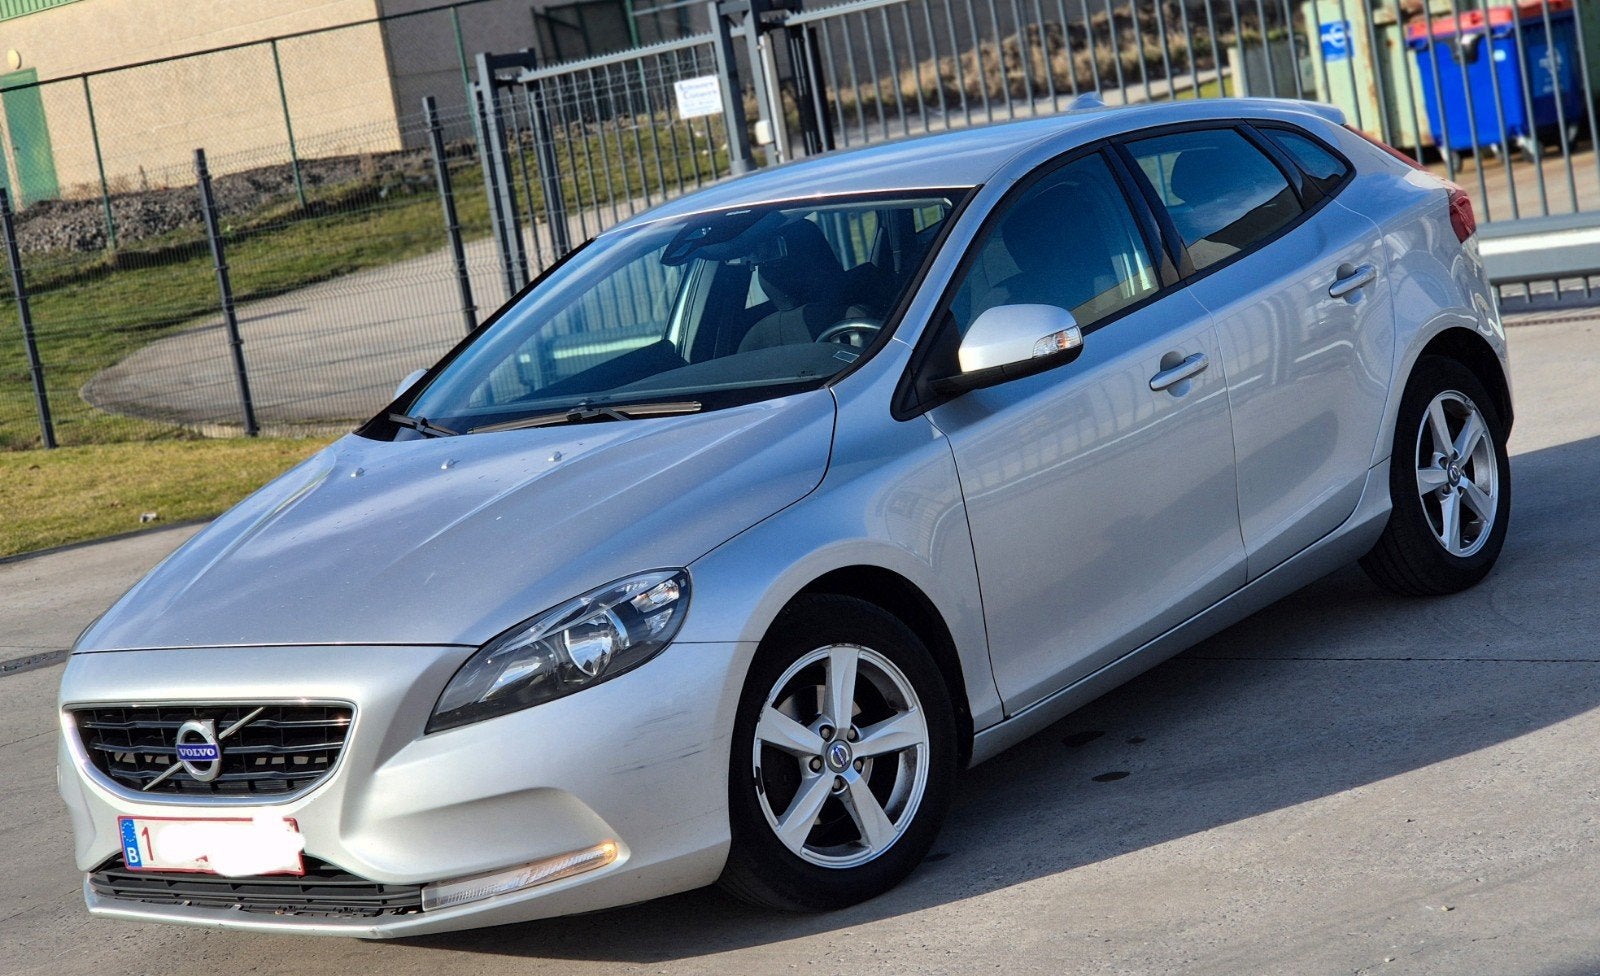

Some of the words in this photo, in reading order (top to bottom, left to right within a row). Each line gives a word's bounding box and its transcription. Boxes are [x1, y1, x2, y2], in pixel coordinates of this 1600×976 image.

[178, 748, 216, 757] VOLVO
[127, 847, 140, 863] B
[141, 827, 154, 861] 1
